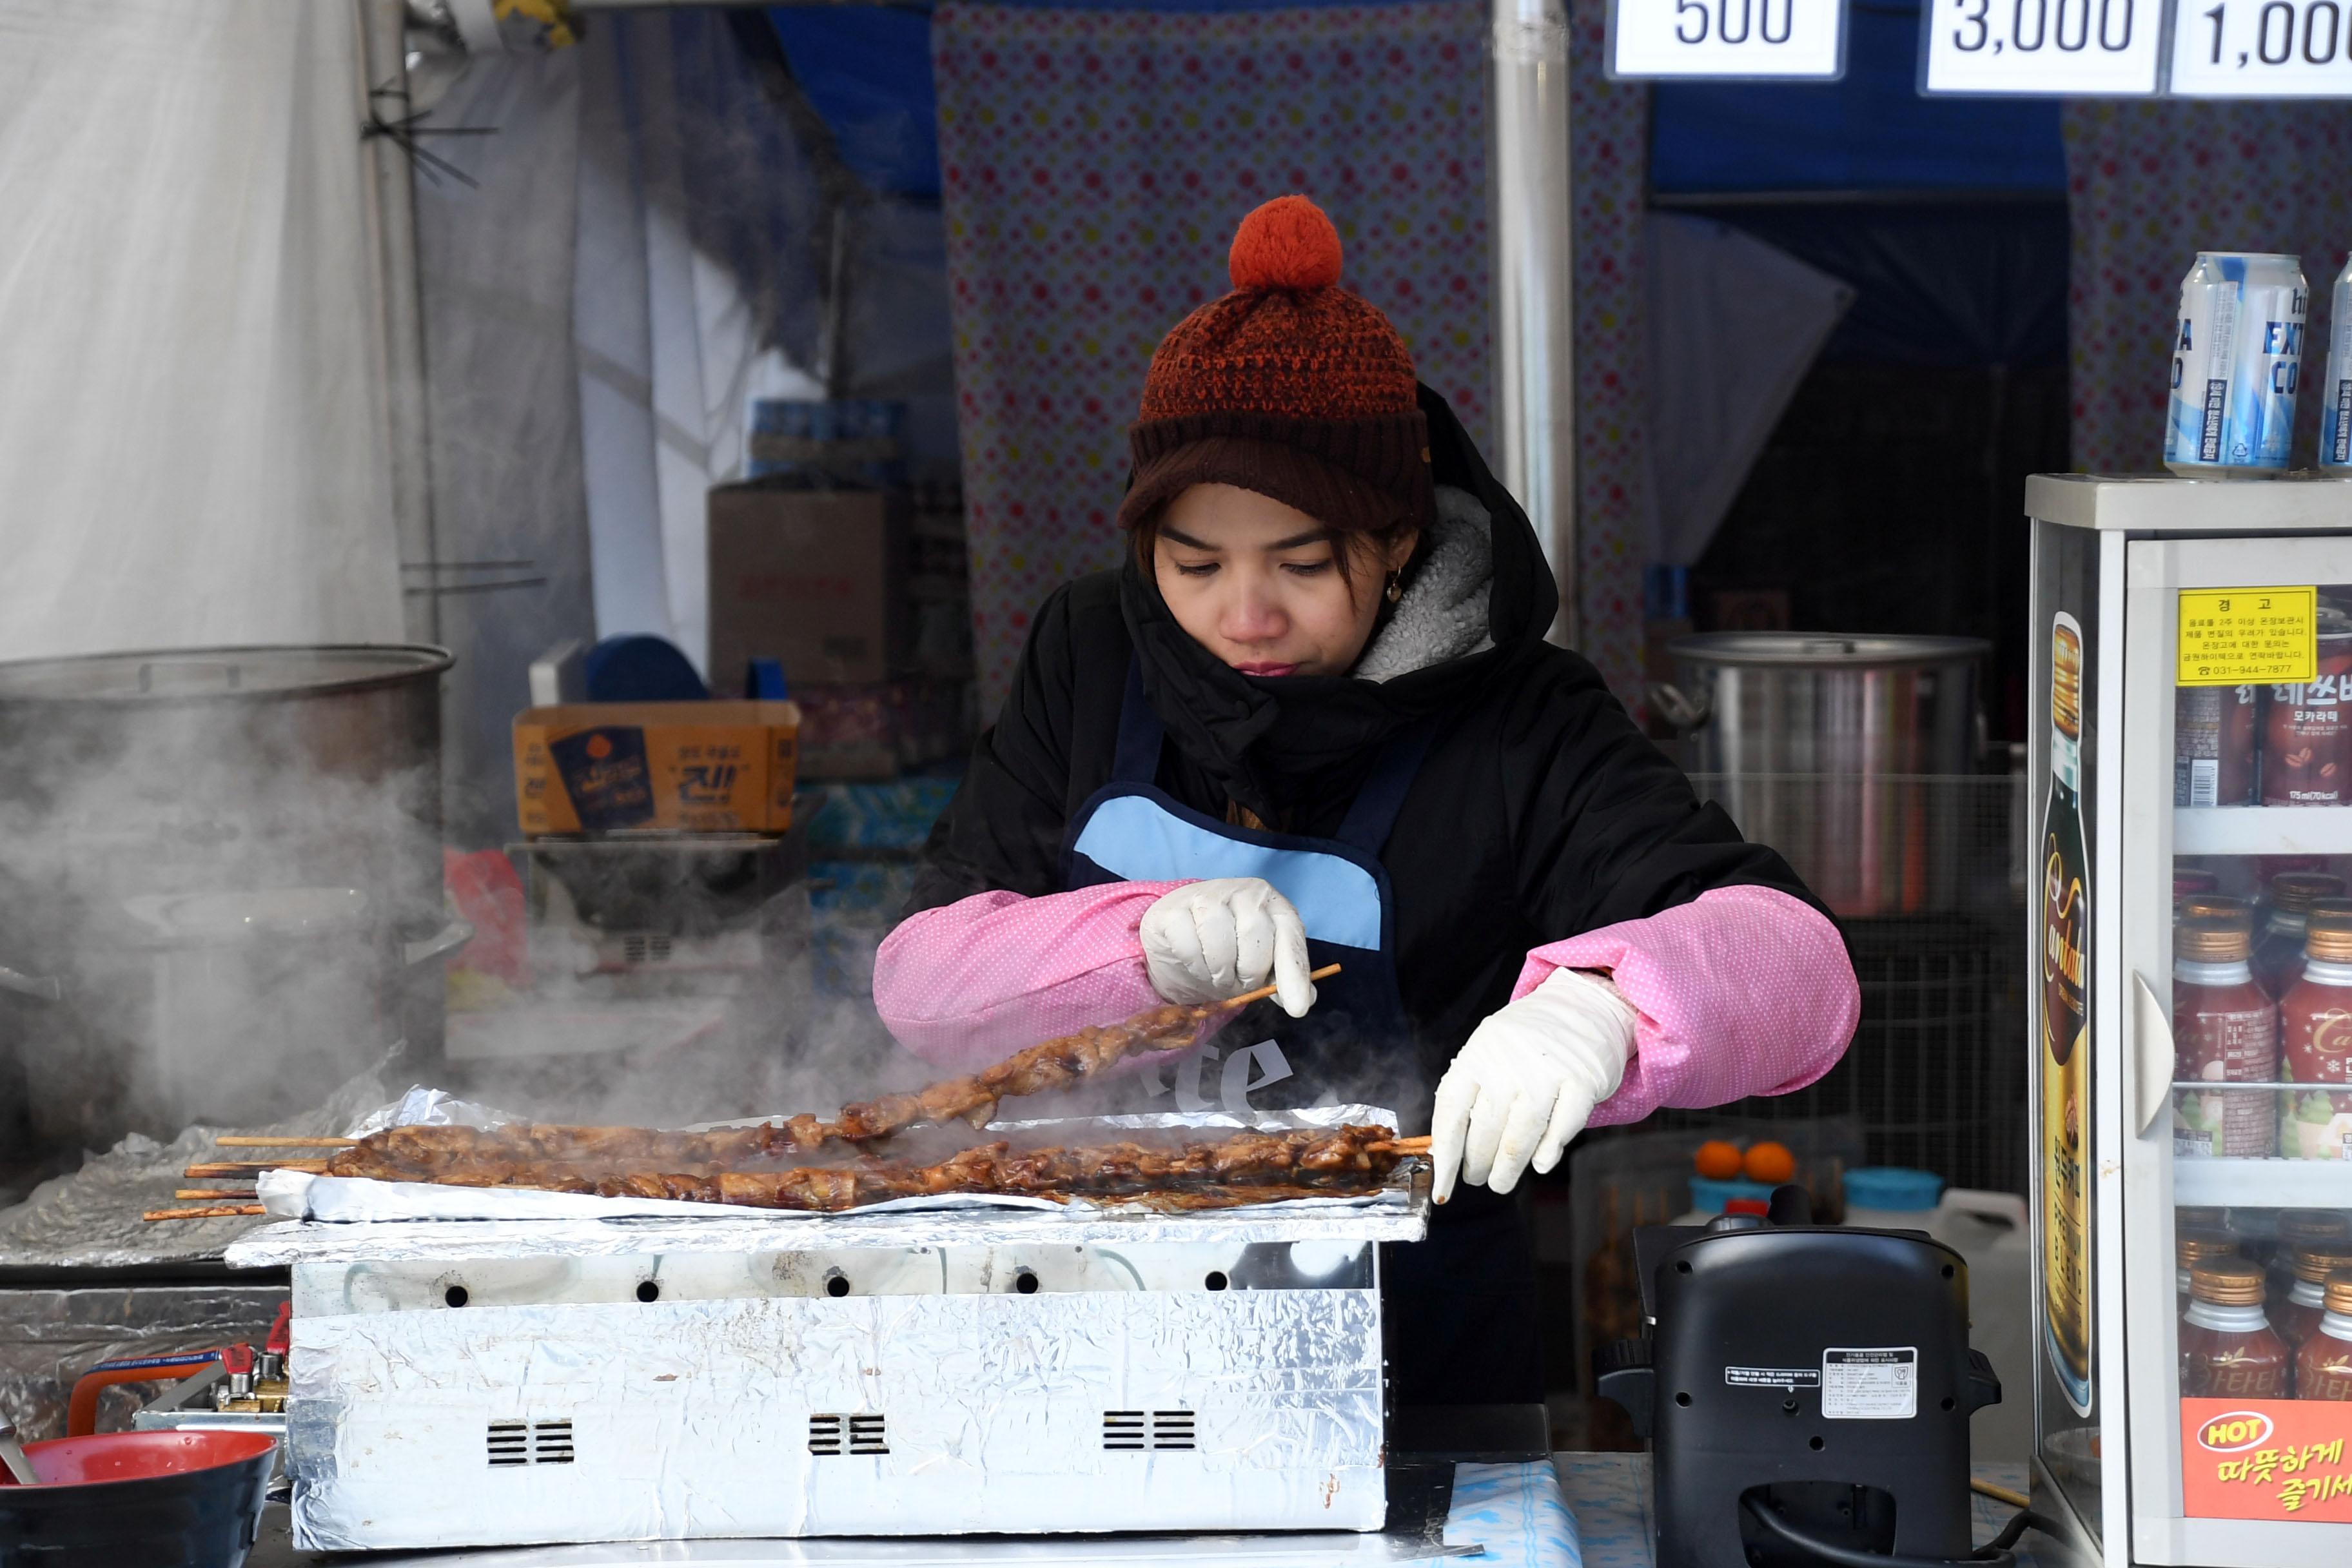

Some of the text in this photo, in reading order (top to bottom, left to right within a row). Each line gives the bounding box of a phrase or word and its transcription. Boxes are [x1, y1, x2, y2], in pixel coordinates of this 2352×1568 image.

[1675, 0, 1793, 44] 500
[1953, 0, 2133, 55] 3,000
[2203, 0, 2352, 69] 1,00
[2238, 617, 2255, 625] 이상
[2185, 630, 2202, 638] 제품
[2238, 629, 2264, 638] 우려가
[2202, 640, 2290, 650] 온장고에 대한 문의는
[2213, 664, 2292, 674] 031-944-7877
[2293, 710, 2339, 723] 모카라떼
[2208, 1418, 2262, 1446] HOT
[2217, 1438, 2345, 1485] 따뜻하게
